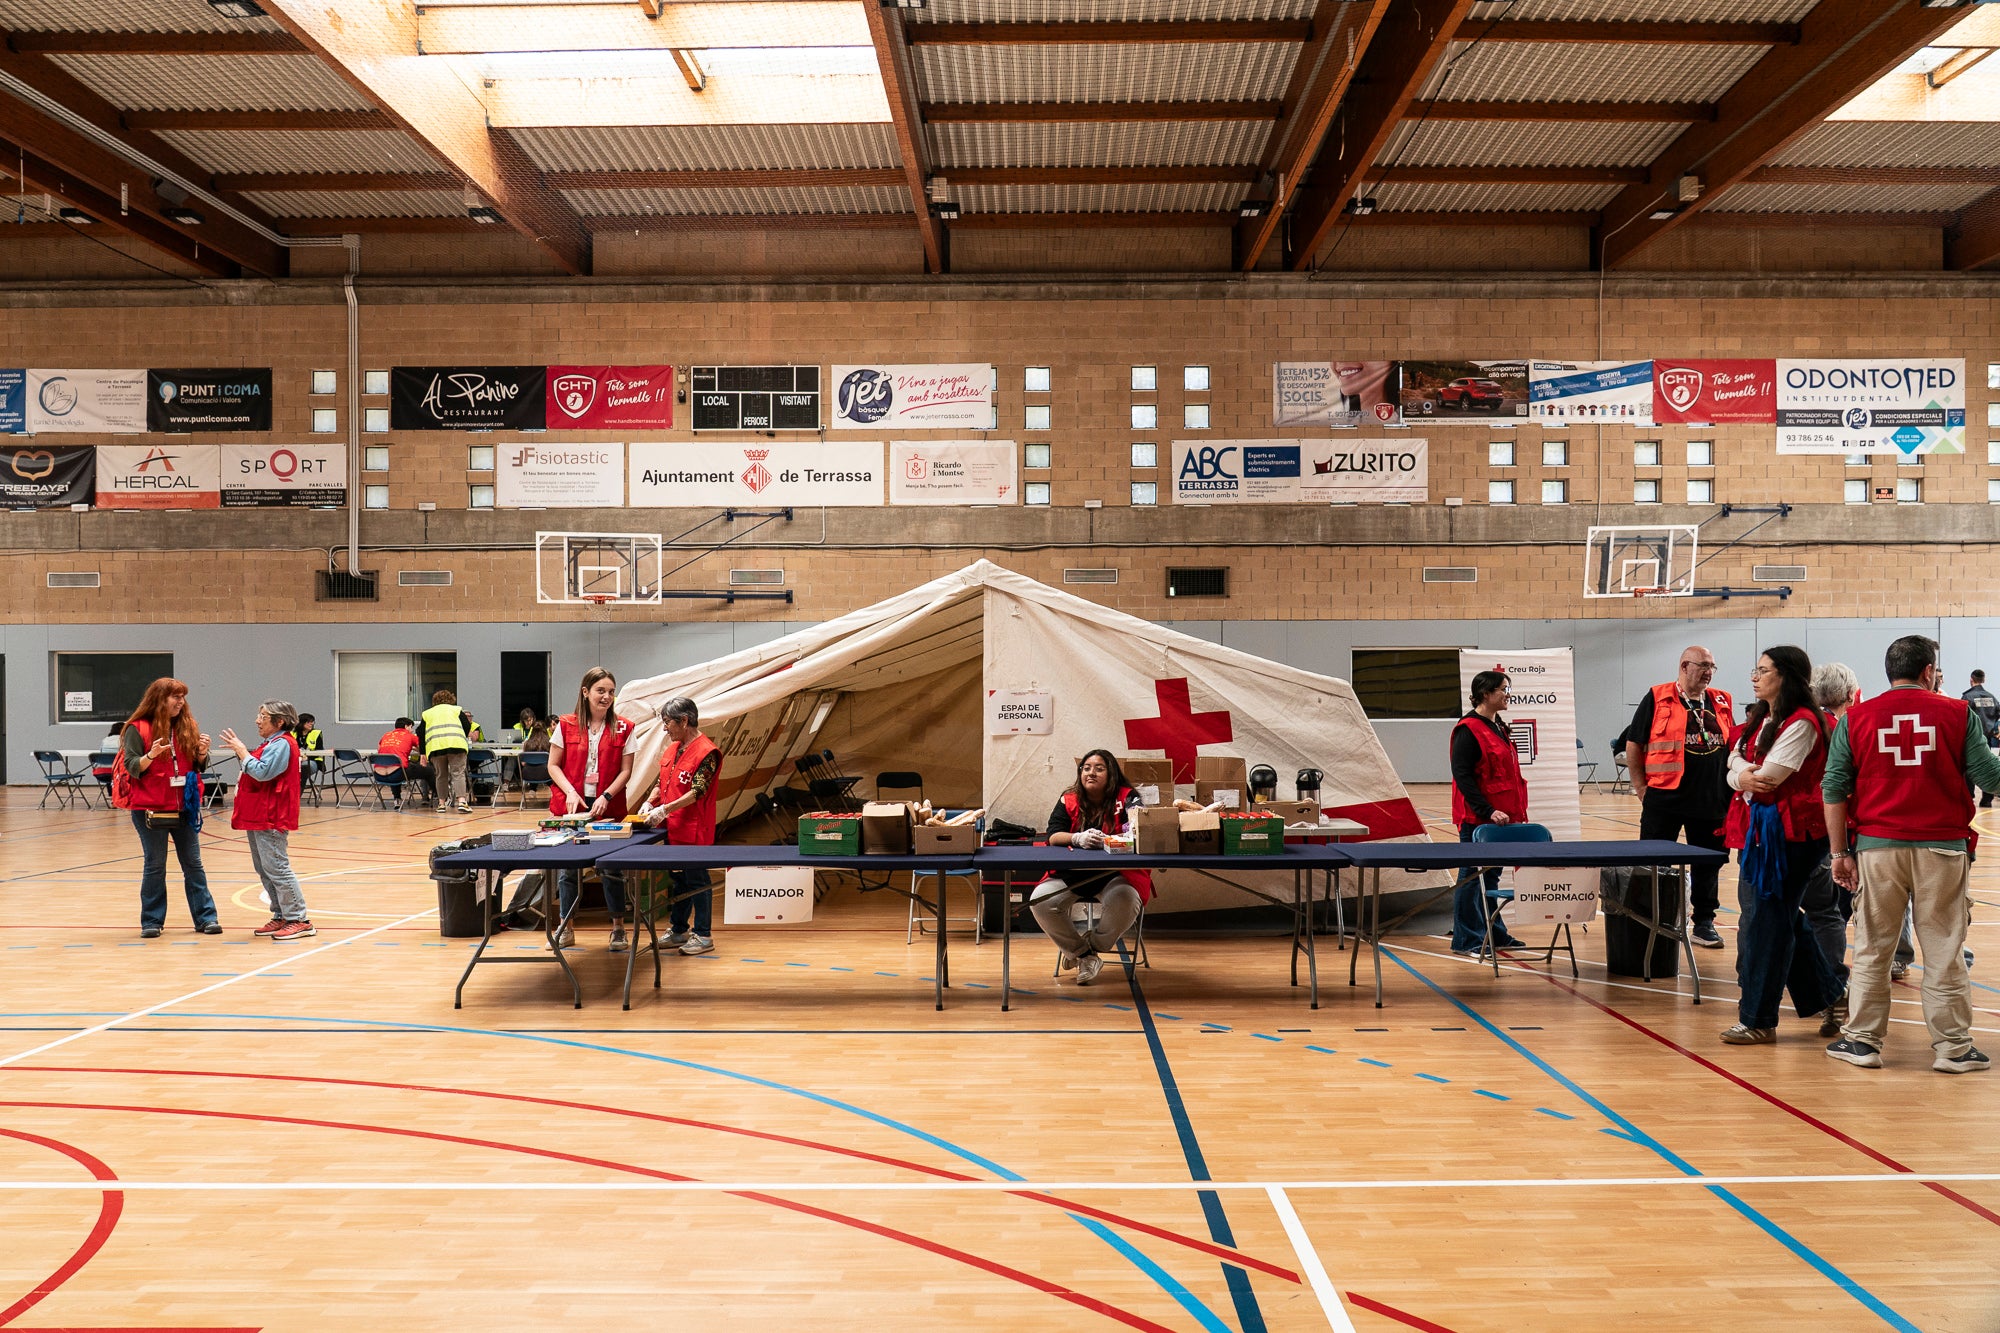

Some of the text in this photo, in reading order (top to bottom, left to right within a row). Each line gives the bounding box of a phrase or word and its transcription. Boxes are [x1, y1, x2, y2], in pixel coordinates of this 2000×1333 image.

[1308, 368, 1330, 380] 15%
[1596, 371, 1621, 380] DISSENYA
[1665, 375, 1697, 384] CHT
[1712, 372, 1755, 385] Tots som
[558, 382, 591, 390] CHT
[606, 379, 650, 392] Tots som
[898, 376, 926, 390] Vine
[938, 375, 969, 390] jugar
[1786, 368, 1956, 398] ODONTOMED
[180, 384, 260, 396] PUNT i COMA
[420, 372, 519, 420] Al Panino
[836, 371, 892, 418] jet
[907, 385, 987, 403] amb nosaltres!
[1714, 382, 1771, 401] Vermells !!
[608, 388, 665, 408] Vermells !!
[702, 396, 729, 405] LOCAL
[780, 396, 811, 405] VISITANT
[1284, 391, 1322, 402] SOCIS
[170, 415, 250, 424] www.punticoma.com
[744, 416, 768, 426] PERIODE
[1846, 408, 1867, 427] jet
[524, 447, 609, 464] Fisiotastic
[1179, 446, 1238, 479] ABC
[1334, 453, 1416, 471] ZURITO
[114, 476, 199, 488] HERCAL
[642, 470, 734, 486] Ajuntament
[780, 470, 872, 482] de Terrassa
[0, 484, 69, 492] FREEDAY21
[1529, 666, 1545, 674] Roja
[1510, 692, 1556, 704] RMACIÓ
[998, 712, 1044, 720] PERSONAL
[736, 888, 804, 898] MENJADOR
[1520, 891, 1595, 902] D'INFORMACIÓ
